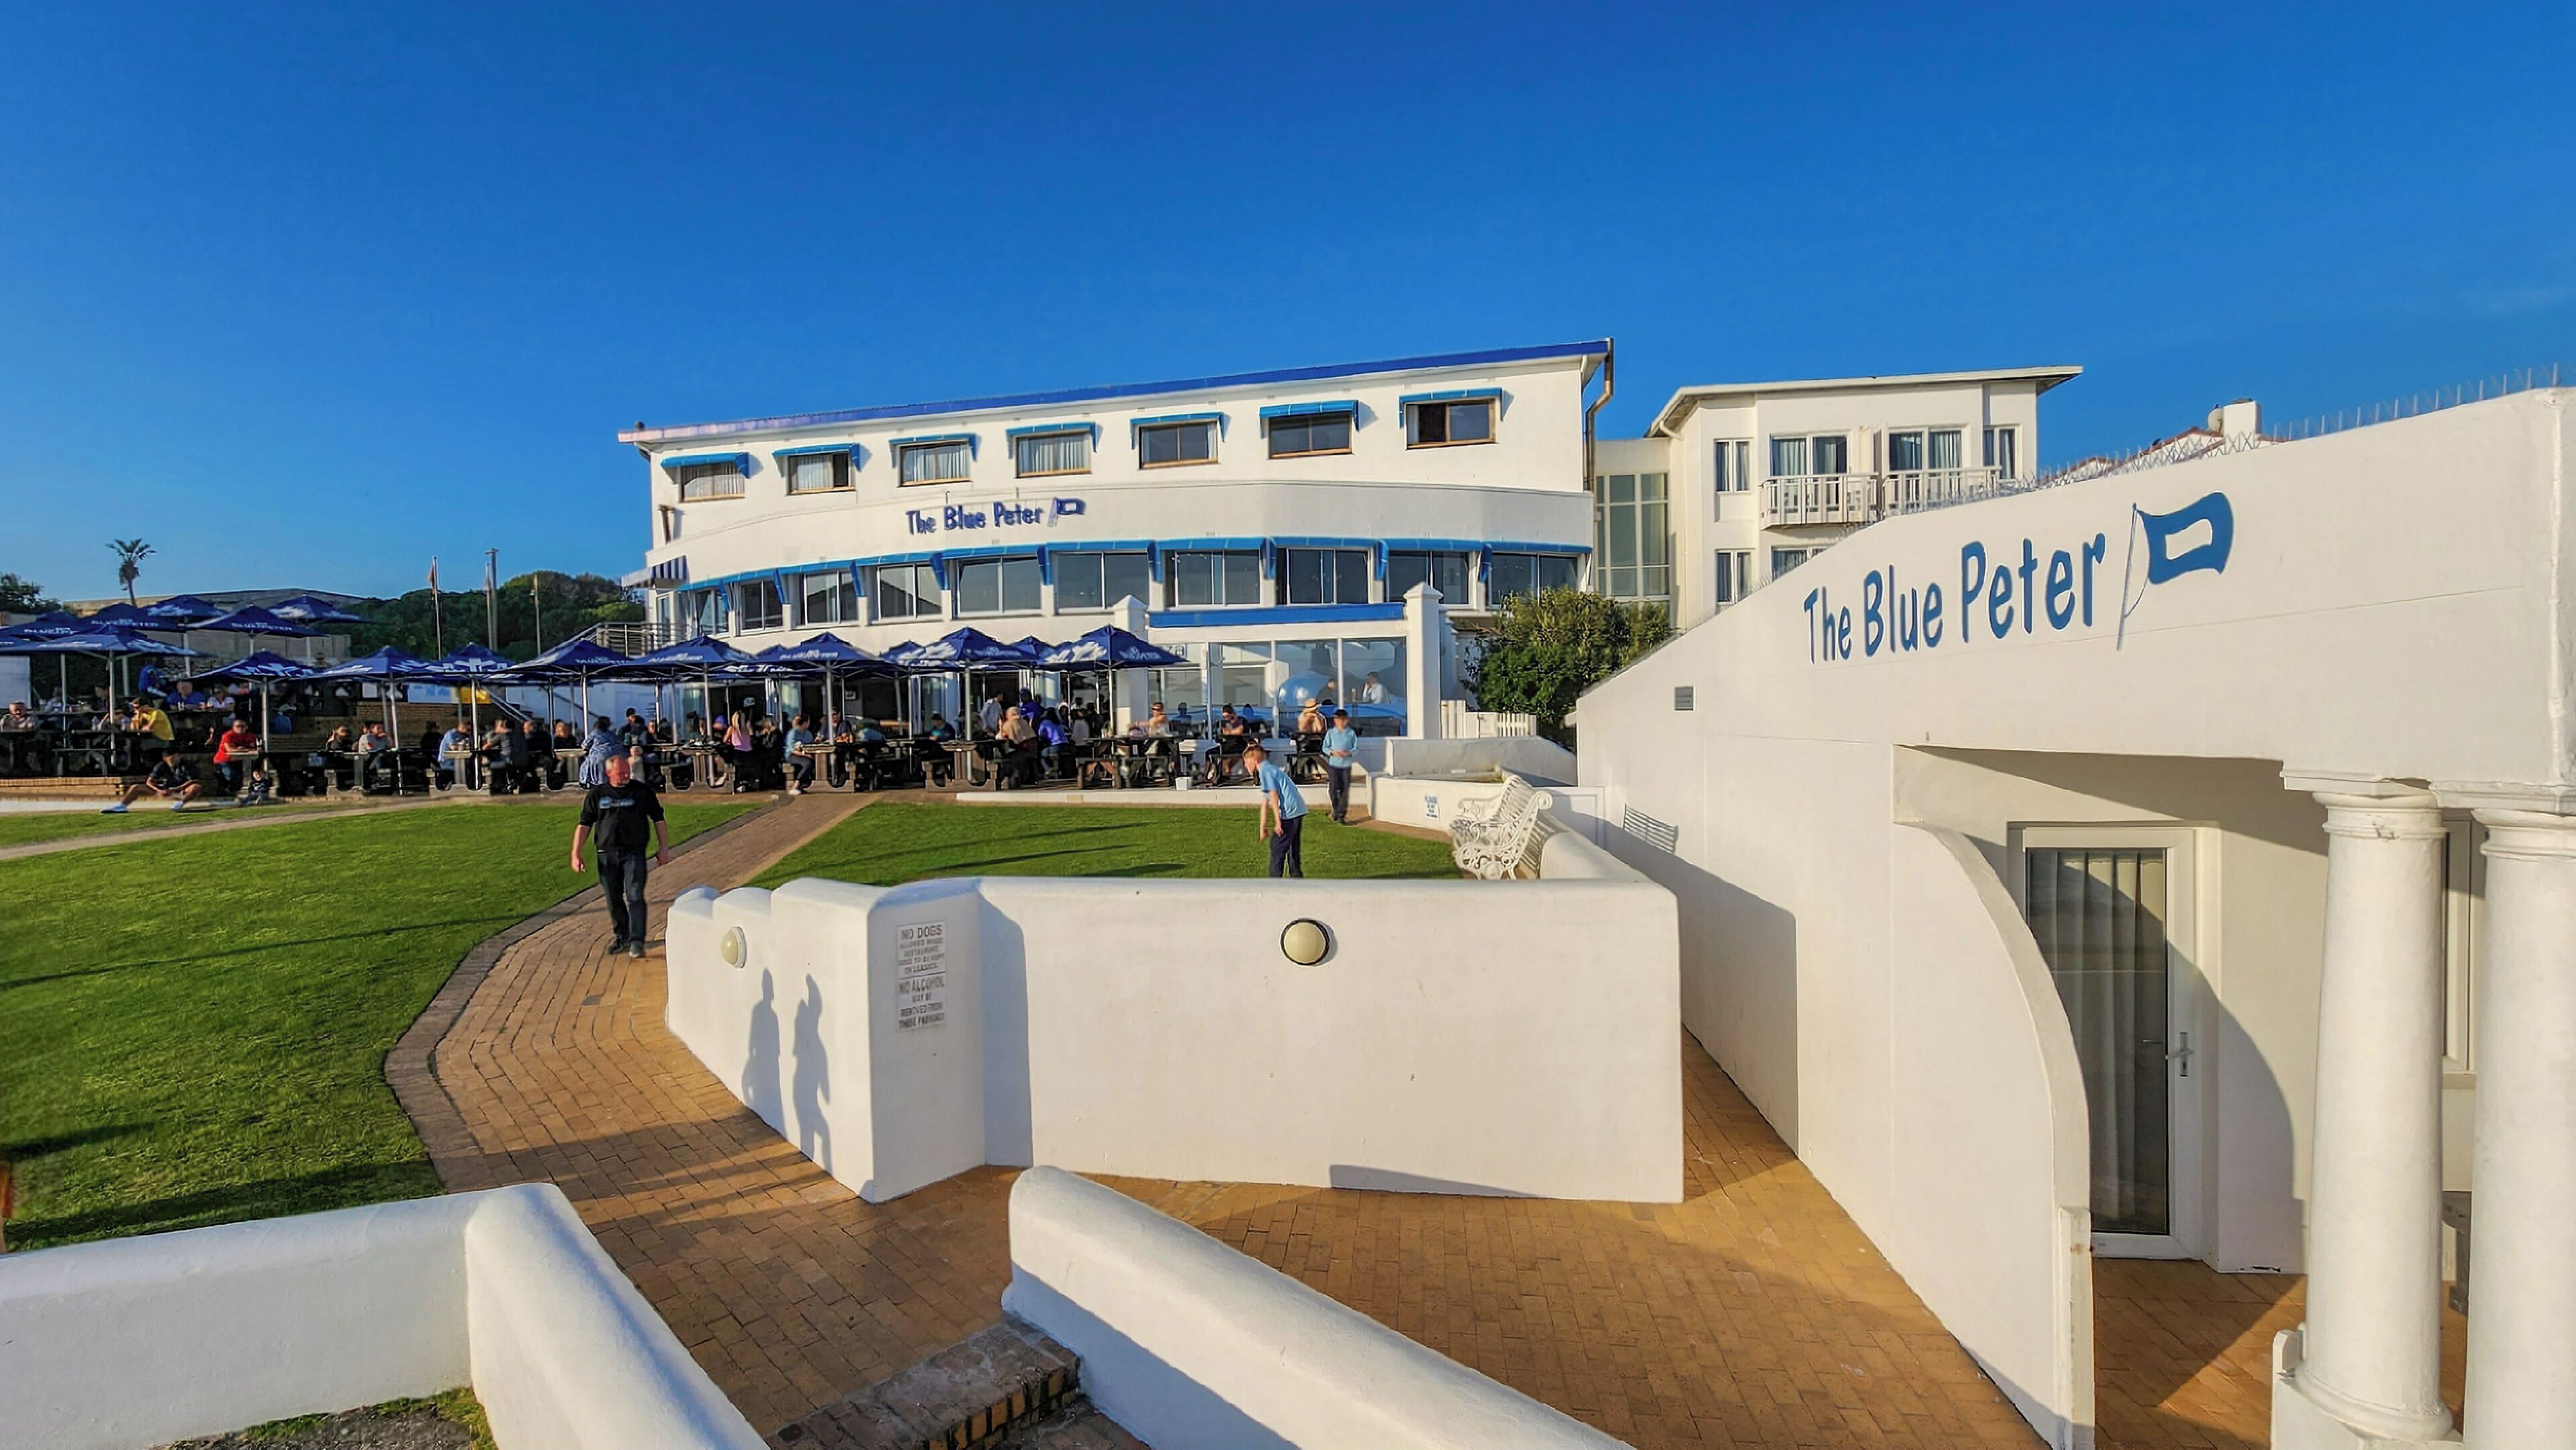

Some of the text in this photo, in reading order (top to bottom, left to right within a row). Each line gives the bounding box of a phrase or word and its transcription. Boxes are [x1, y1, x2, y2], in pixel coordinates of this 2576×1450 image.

[906, 501, 1044, 535] The Blue Peter
[1804, 533, 2105, 664] The Blue Peter
[901, 925, 943, 940] NO DOGS
[899, 976, 945, 994] NO ALCOHOL
